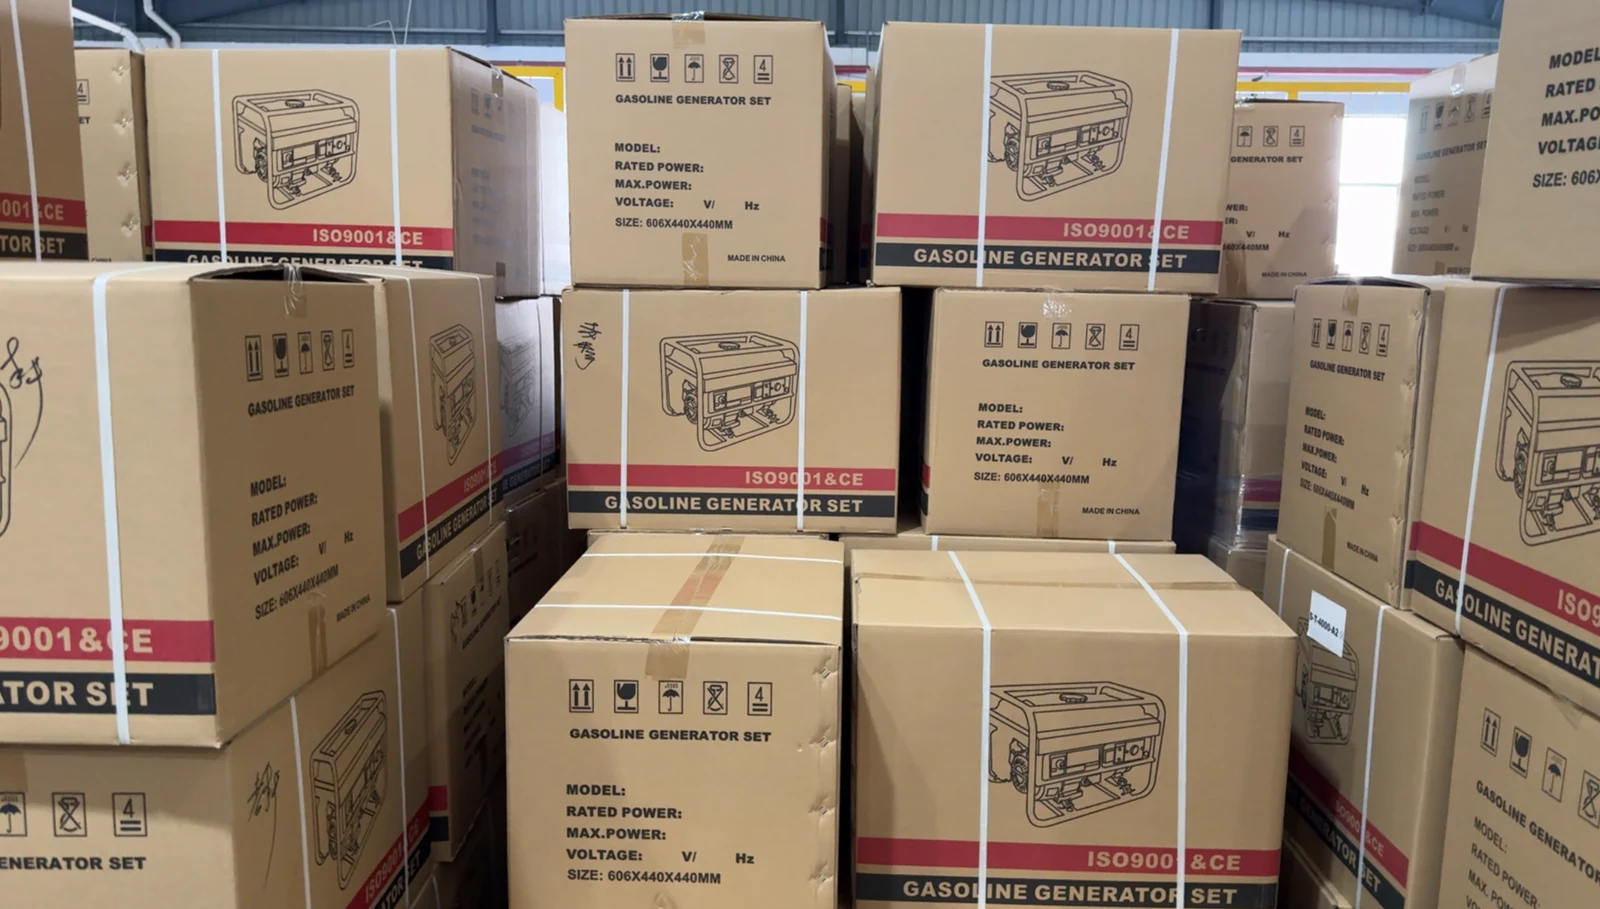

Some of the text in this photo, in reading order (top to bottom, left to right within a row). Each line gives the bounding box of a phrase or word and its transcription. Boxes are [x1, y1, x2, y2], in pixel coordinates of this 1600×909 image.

[1545, 78, 1595, 98] RATED
[615, 94, 771, 106] GASOLINE GENERATOR SET
[615, 143, 660, 153] MODEL:
[615, 160, 704, 173] RATED POWER:
[615, 179, 692, 191] MAX.POWER:
[1533, 172, 1567, 188] SIZE:
[615, 197, 760, 210] VOLTAGE: V/ Hz
[615, 217, 733, 229] SIZE: 606X440X440MM
[313, 228, 423, 245] ISO9001&CE
[1278, 231, 1290, 239] Hz
[727, 254, 786, 263] MADE IN CHINA
[1020, 250, 1143, 268] GENERATOR
[982, 358, 1136, 370] GASOLINE GENERATOR SET
[1309, 360, 1385, 382] GASOLINE GENERATOR SET
[248, 385, 355, 417] GASOLINE GENERATOR SET
[978, 403, 1023, 413] MODEL:
[977, 420, 1064, 432] RATED POWER:
[976, 436, 1051, 448] MAX.POWER:
[1304, 424, 1345, 446] RATED POWER:
[975, 453, 1117, 467] VOLTAGE: V/ Hz
[250, 474, 287, 497] MODEL:
[745, 470, 864, 487] ISO9001&CE
[973, 471, 1090, 484] SIZE: 606X440X440MM
[1300, 477, 1313, 492] SIZE:
[1301, 460, 1327, 479] VOLTAGE:
[1361, 484, 1369, 497] Hz
[251, 492, 318, 527] RATED POWER:
[706, 497, 822, 512] GENERATOR
[827, 498, 863, 513] SET
[1081, 507, 1105, 515] MADE
[1106, 507, 1114, 515] IN
[253, 522, 311, 556] MAX.POWER:
[254, 555, 299, 586] VOLTAGE:
[344, 530, 354, 544] Hz
[255, 597, 278, 620] SIZE:
[570, 728, 772, 743] GASOLINE GENERATOR SET
[566, 784, 626, 796] MODEL:
[1476, 779, 1526, 828] GASOLINE
[566, 806, 682, 819] RATED POWER:
[566, 827, 666, 840] MAX.POWER:
[1473, 816, 1507, 854] MODEL:
[109, 856, 146, 870] SET
[566, 848, 755, 864] VOLTAGE: V/ Hz
[1088, 850, 1242, 871] ISO900&CE
[1471, 842, 1501, 877] RATED
[567, 868, 721, 884] SIZE: 606X440X440MM
[903, 880, 1028, 901] GASOLINE
[1191, 887, 1238, 905] SET
